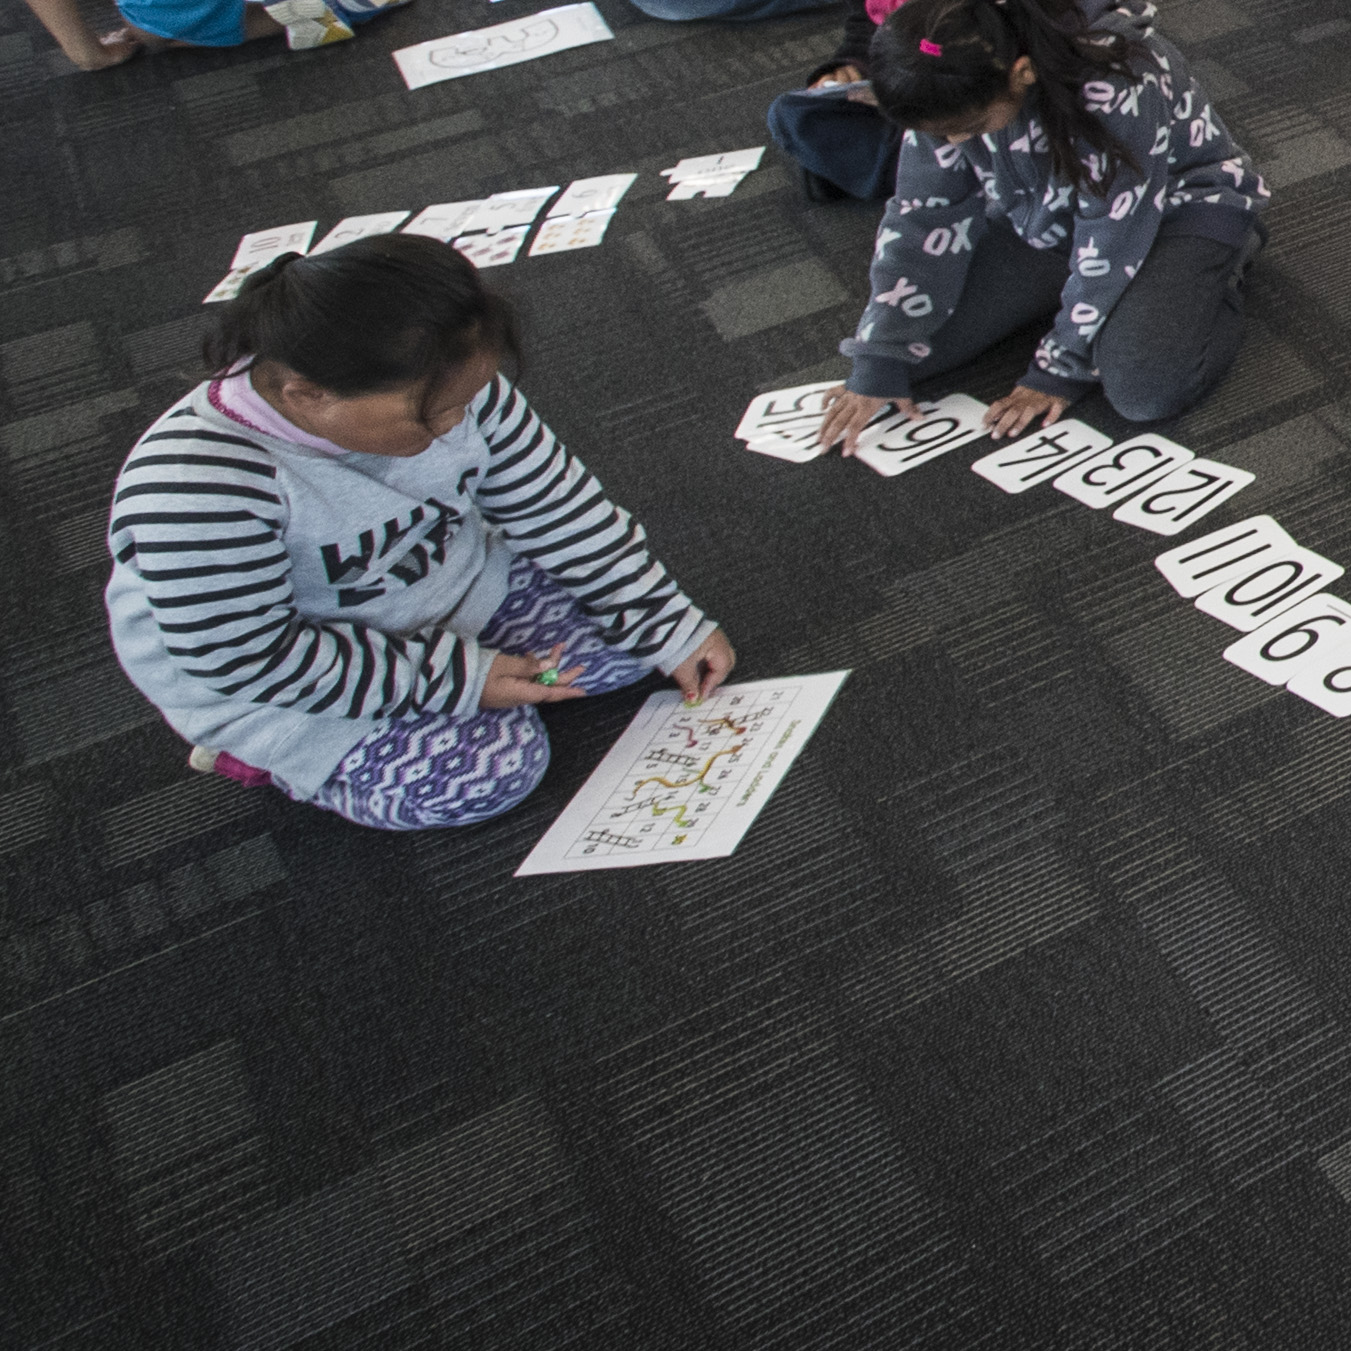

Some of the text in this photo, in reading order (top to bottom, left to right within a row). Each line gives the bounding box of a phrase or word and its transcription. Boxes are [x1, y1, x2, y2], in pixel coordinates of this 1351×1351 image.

[877, 418, 976, 463] 16
[999, 432, 1092, 481] 14
[1082, 445, 1173, 494] 13
[1142, 470, 1233, 521] 12
[1179, 530, 1271, 579] 11
[1225, 561, 1321, 616] 10
[1260, 615, 1345, 661] 9
